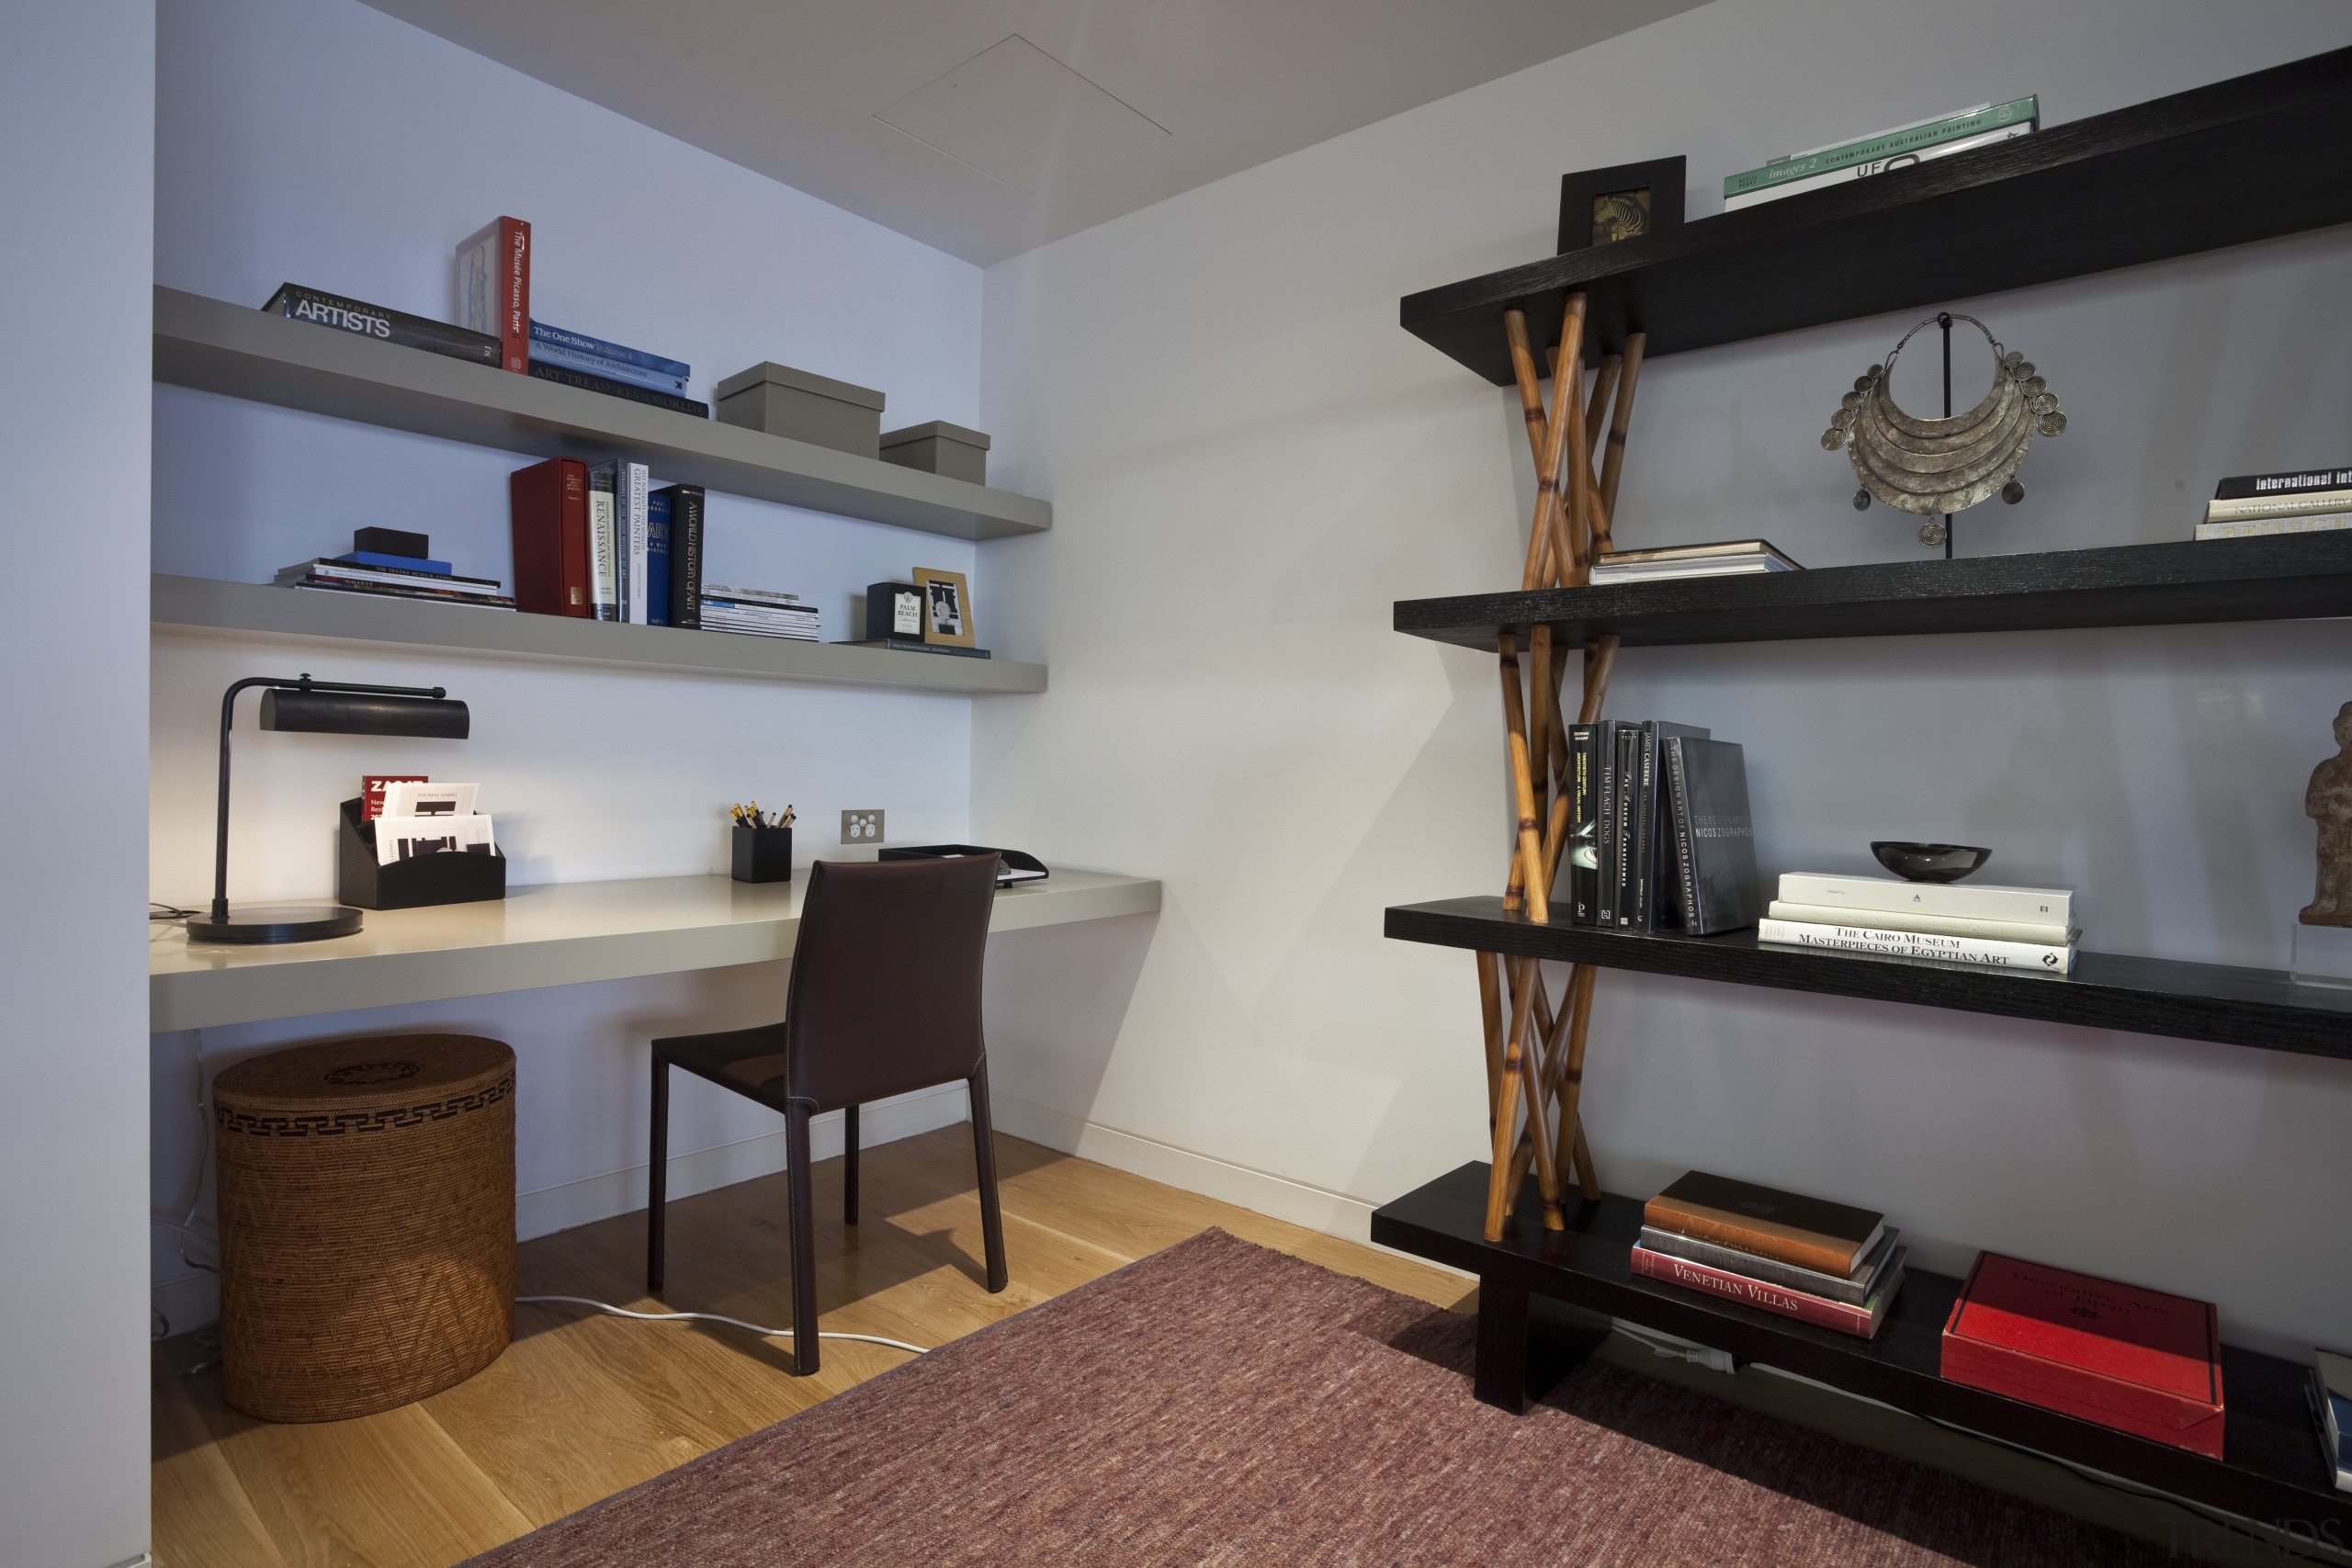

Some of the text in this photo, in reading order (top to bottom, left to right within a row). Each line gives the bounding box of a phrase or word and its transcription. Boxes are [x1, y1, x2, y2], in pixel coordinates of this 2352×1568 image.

[1826, 119, 1982, 164] CONTEMPORARY AUSTRALIAN PAINTING
[1769, 163, 1805, 179] images
[1809, 158, 1817, 168] 2
[514, 231, 523, 245] The
[296, 291, 391, 319] CONTEMPORARY
[512, 276, 522, 309] Picasso,
[295, 299, 390, 338] ARTISTS
[512, 310, 521, 333] Paris
[533, 326, 632, 360] The One Show Volume 4
[543, 343, 566, 355] World
[567, 352, 595, 365] History
[605, 361, 648, 378] Architecture
[535, 366, 563, 380] ART
[565, 373, 639, 399] TREASURES
[651, 395, 696, 413] WORLD
[2256, 472, 2332, 491] international
[2234, 498, 2349, 513] NATIONAL GALLERY
[596, 501, 606, 577] RENAISSANCE
[688, 510, 697, 541] WORLD
[687, 542, 696, 581] HISTORY
[687, 593, 695, 613] ART
[898, 610, 918, 618] BEACH
[1672, 765, 1681, 798] DESIGN
[1679, 819, 1685, 829] OF
[1695, 828, 1753, 838] NICOS ZOGRAPHOS
[1679, 832, 1688, 860] NICOS
[1683, 863, 1694, 918] ZOGRAPHOS
[1799, 933, 2010, 964] MASTERPIECES OF EGYPTIAN ART
[1835, 927, 1960, 948] THE CAIRO MUSEUM
[1653, 1236, 1701, 1258] MOORISH
[1704, 1248, 1736, 1269] STYLE
[1673, 1263, 1742, 1295] VENETIAN
[1747, 1283, 1798, 1311] VILLAS
